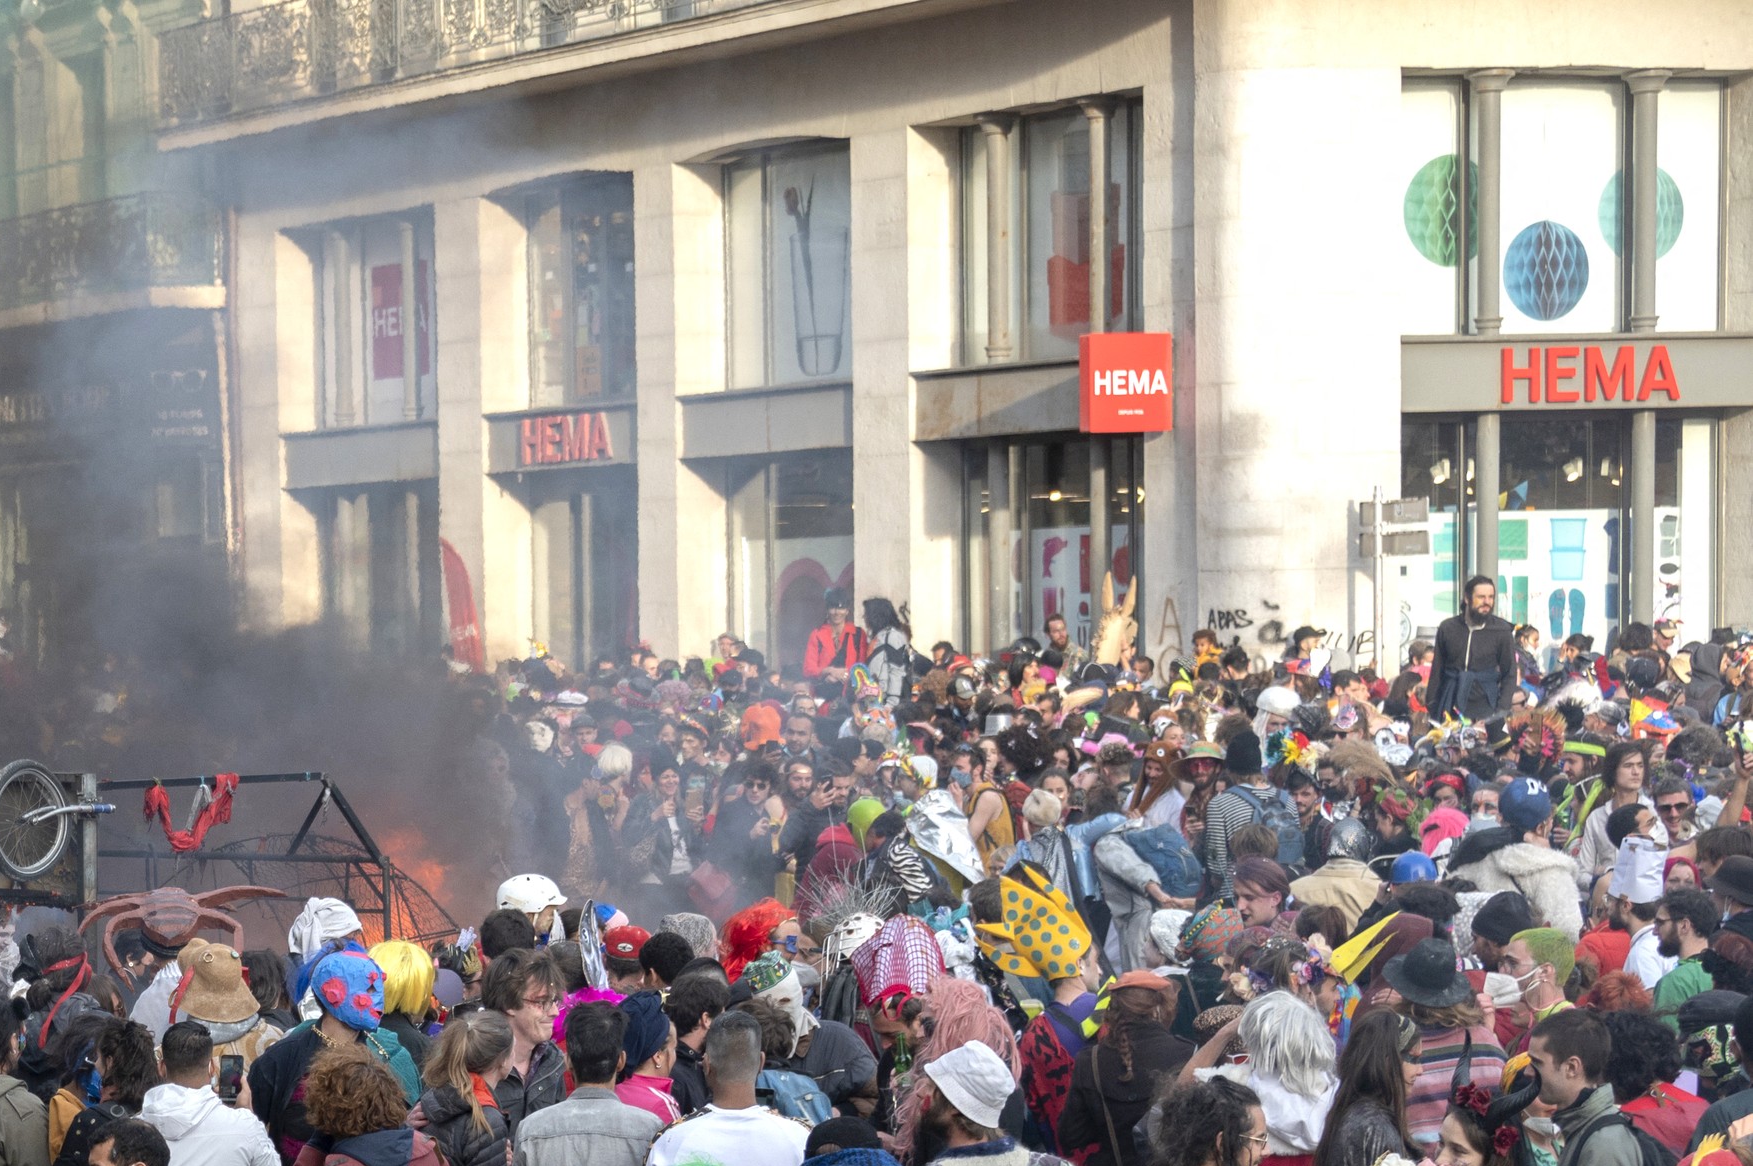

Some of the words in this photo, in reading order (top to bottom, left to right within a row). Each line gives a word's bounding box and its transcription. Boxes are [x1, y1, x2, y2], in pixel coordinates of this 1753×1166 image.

[373, 304, 427, 338] HEA
[1093, 368, 1169, 396] HEMA
[1500, 344, 1681, 404] HEMA
[521, 412, 613, 465] HEMA
